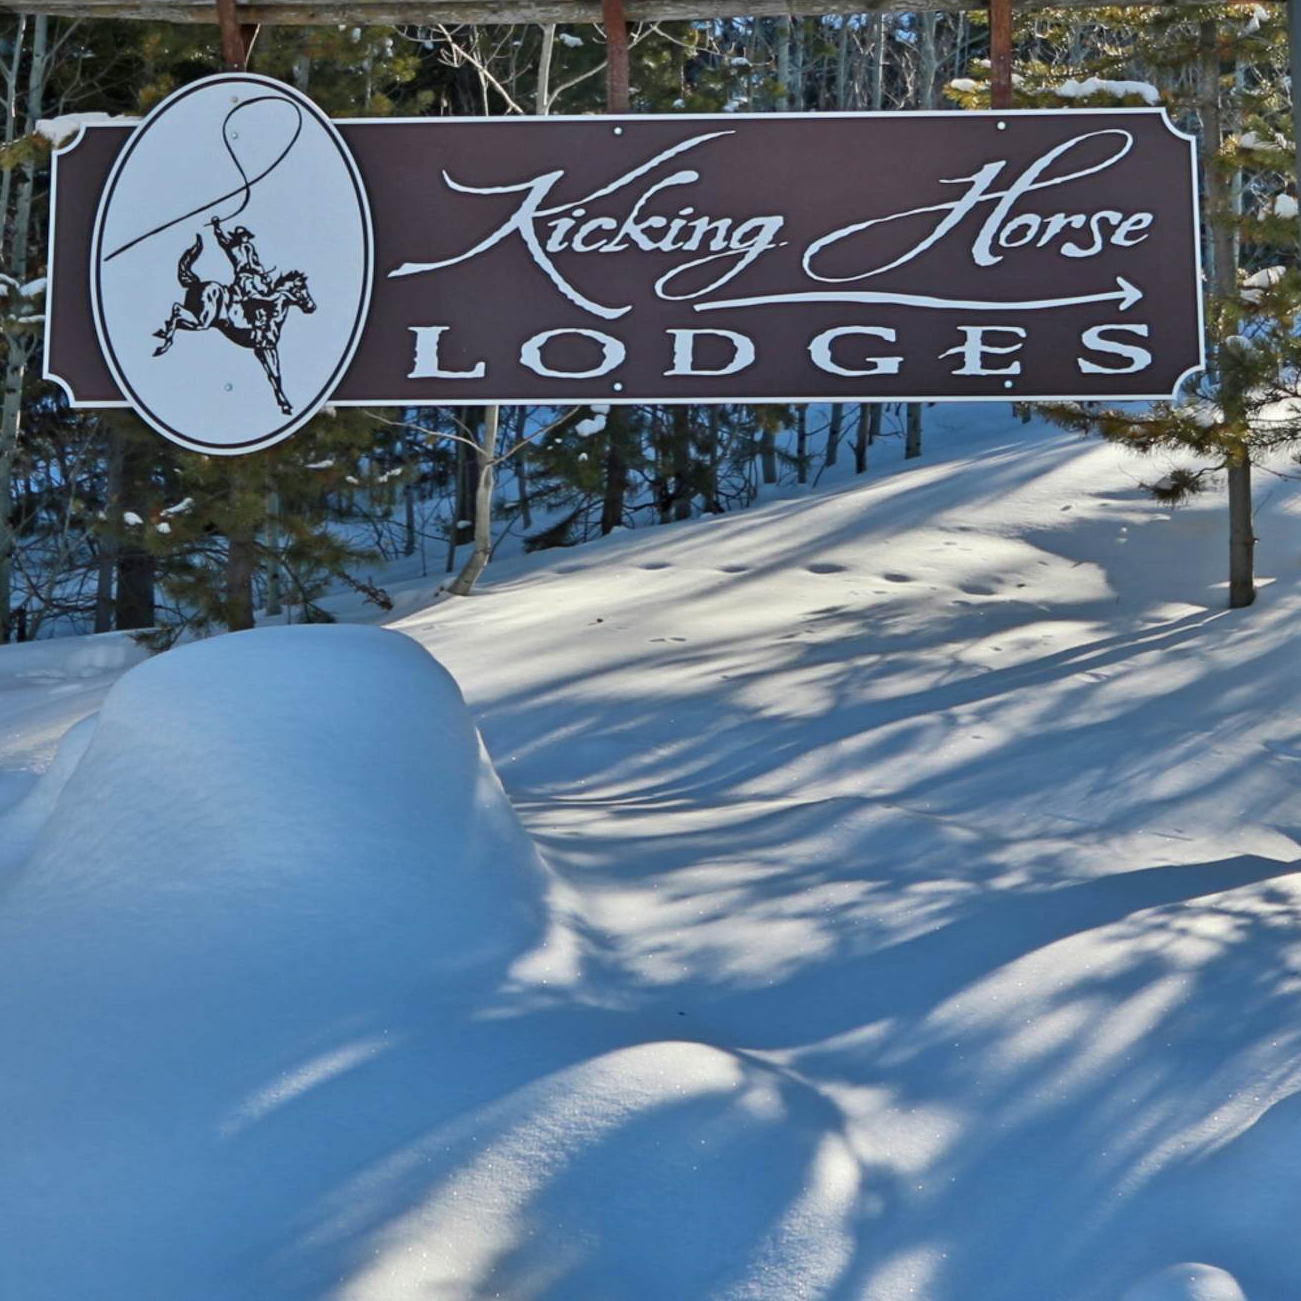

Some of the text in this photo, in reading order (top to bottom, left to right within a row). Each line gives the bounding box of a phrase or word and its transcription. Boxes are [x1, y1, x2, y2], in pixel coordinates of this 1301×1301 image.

[387, 128, 1154, 320] Kicking Horse
[406, 323, 1153, 379] LODGES
